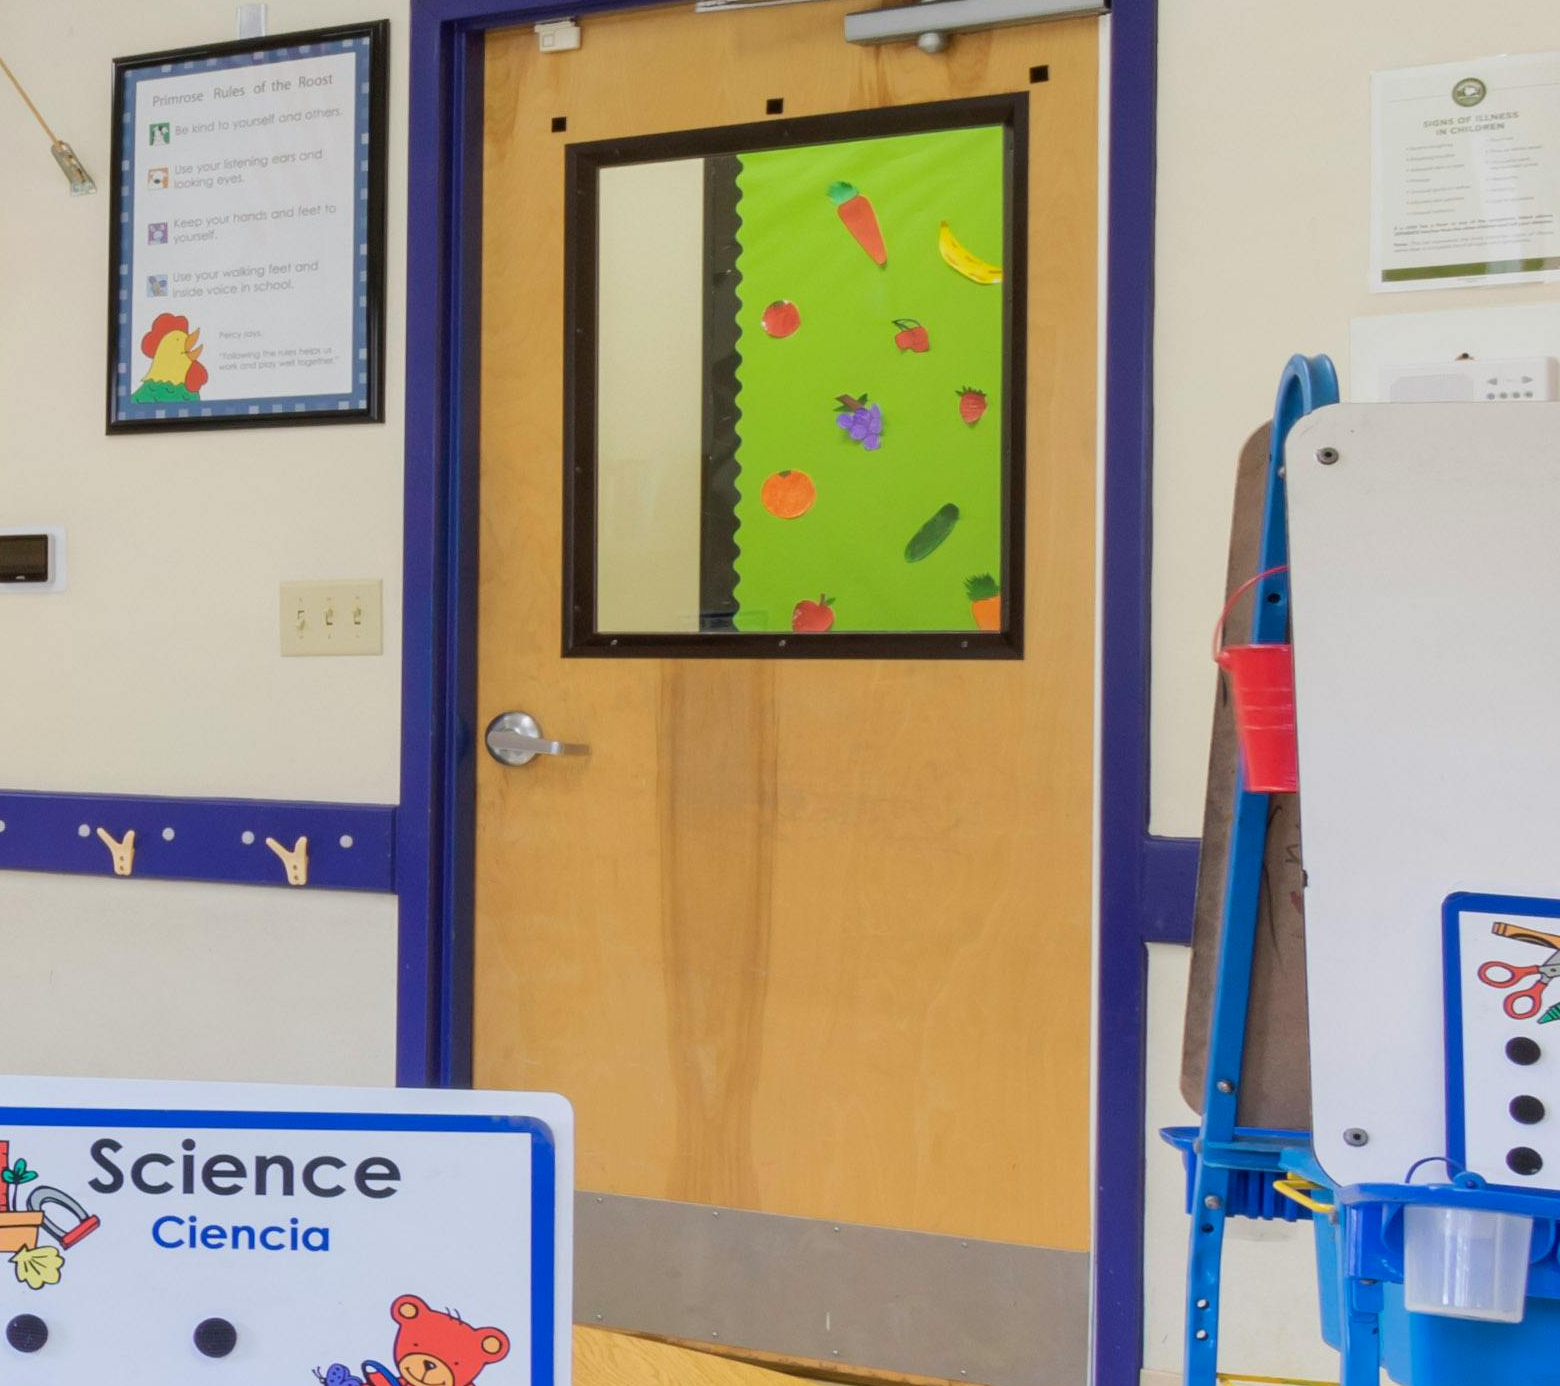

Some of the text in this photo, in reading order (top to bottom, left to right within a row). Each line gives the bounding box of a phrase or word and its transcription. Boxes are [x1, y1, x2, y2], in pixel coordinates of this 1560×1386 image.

[152, 74, 333, 107] Primrose Rules of the Roost
[174, 125, 189, 136] Be
[192, 121, 215, 134] kind
[218, 122, 230, 131] to
[232, 111, 275, 131] yourself
[278, 110, 302, 123] and
[1423, 111, 1520, 128] SIGNS OF ILLNESS
[1436, 122, 1505, 136] IN CHILDREN
[174, 148, 323, 175] Use your listening ears and
[174, 177, 214, 190] looking
[173, 203, 337, 229] Keep your hands and feet to
[172, 261, 319, 283] Use your walking feet and
[206, 284, 238, 296] voice
[241, 282, 251, 293] in
[87, 1138, 402, 1199] Science
[151, 1215, 332, 1253] Ciencia
